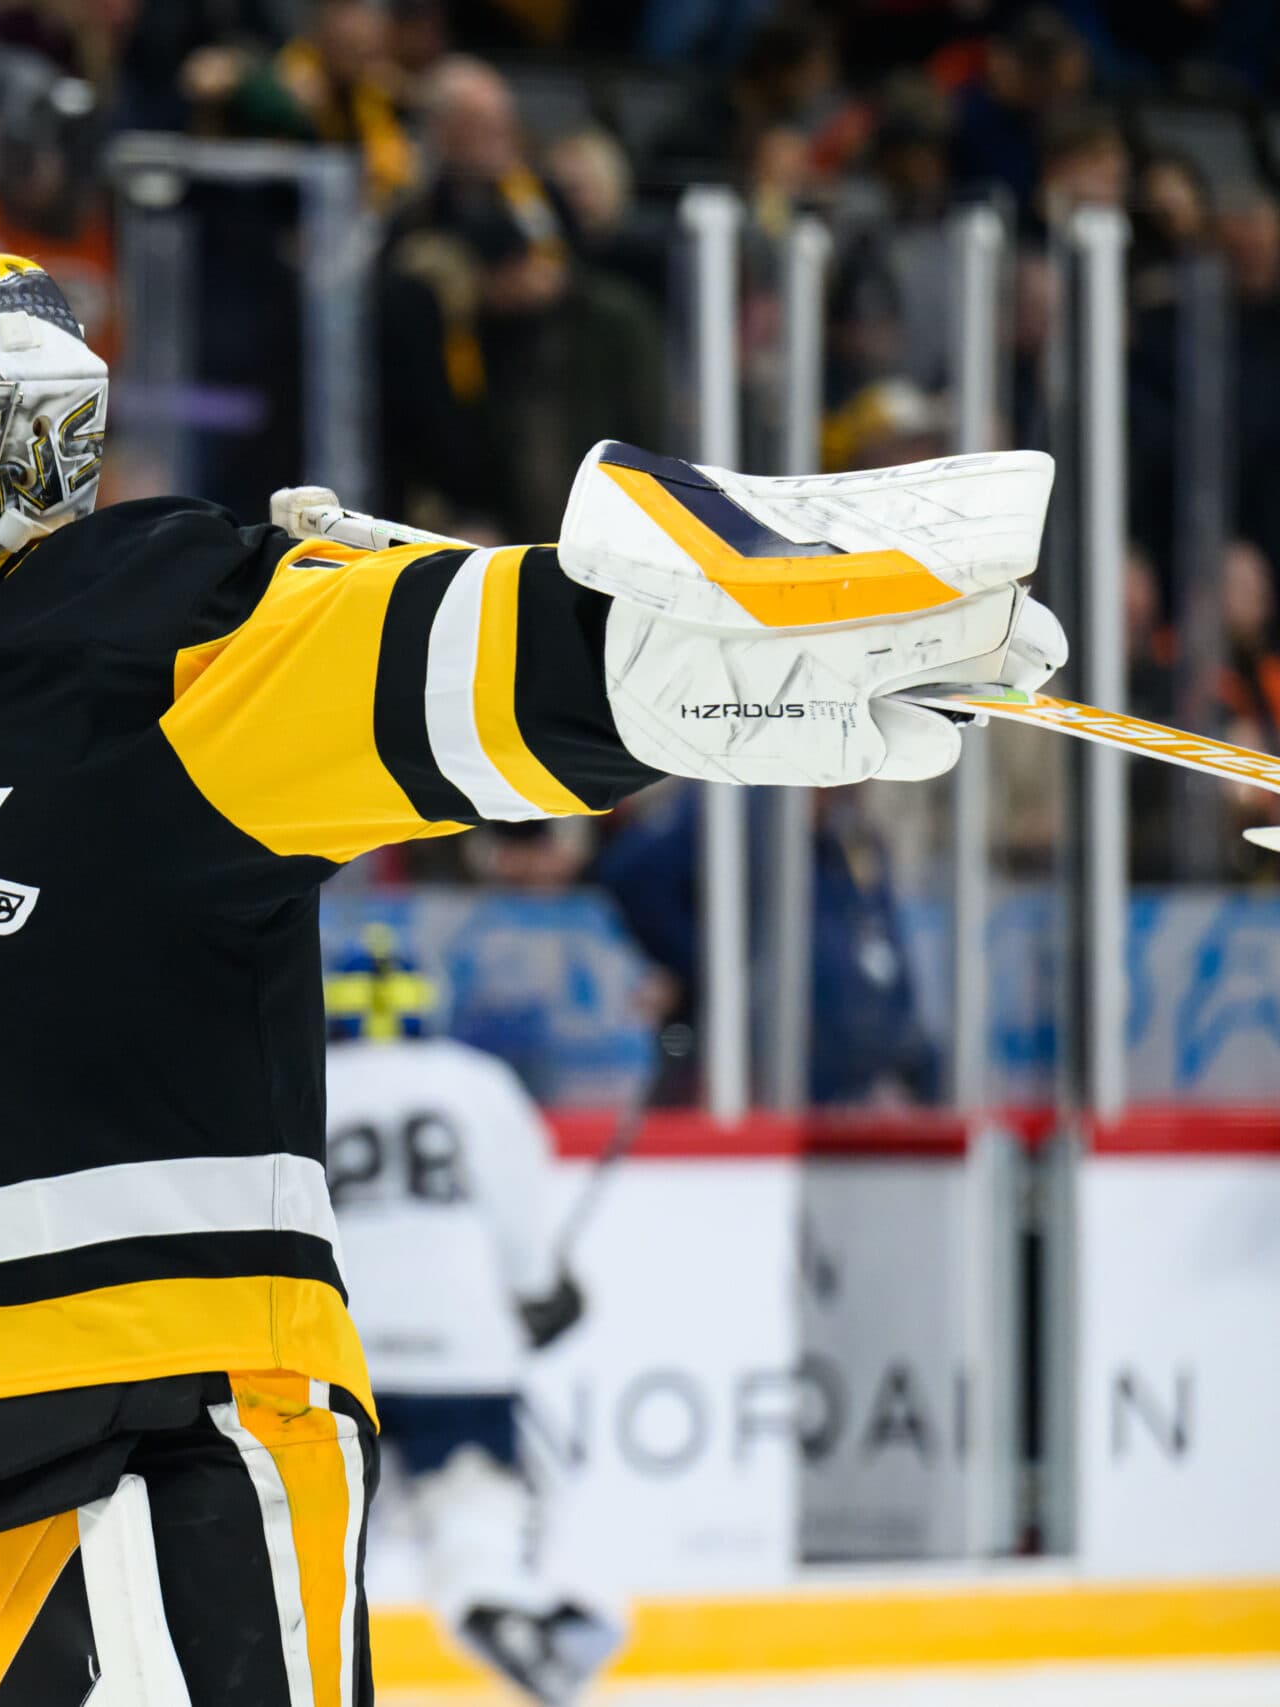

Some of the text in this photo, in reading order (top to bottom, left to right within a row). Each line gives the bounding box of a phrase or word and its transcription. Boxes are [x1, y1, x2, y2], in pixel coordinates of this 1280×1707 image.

[681, 704, 805, 719] HZRDUS
[1025, 707, 1280, 785] AUER
[326, 1109, 470, 1208] 28
